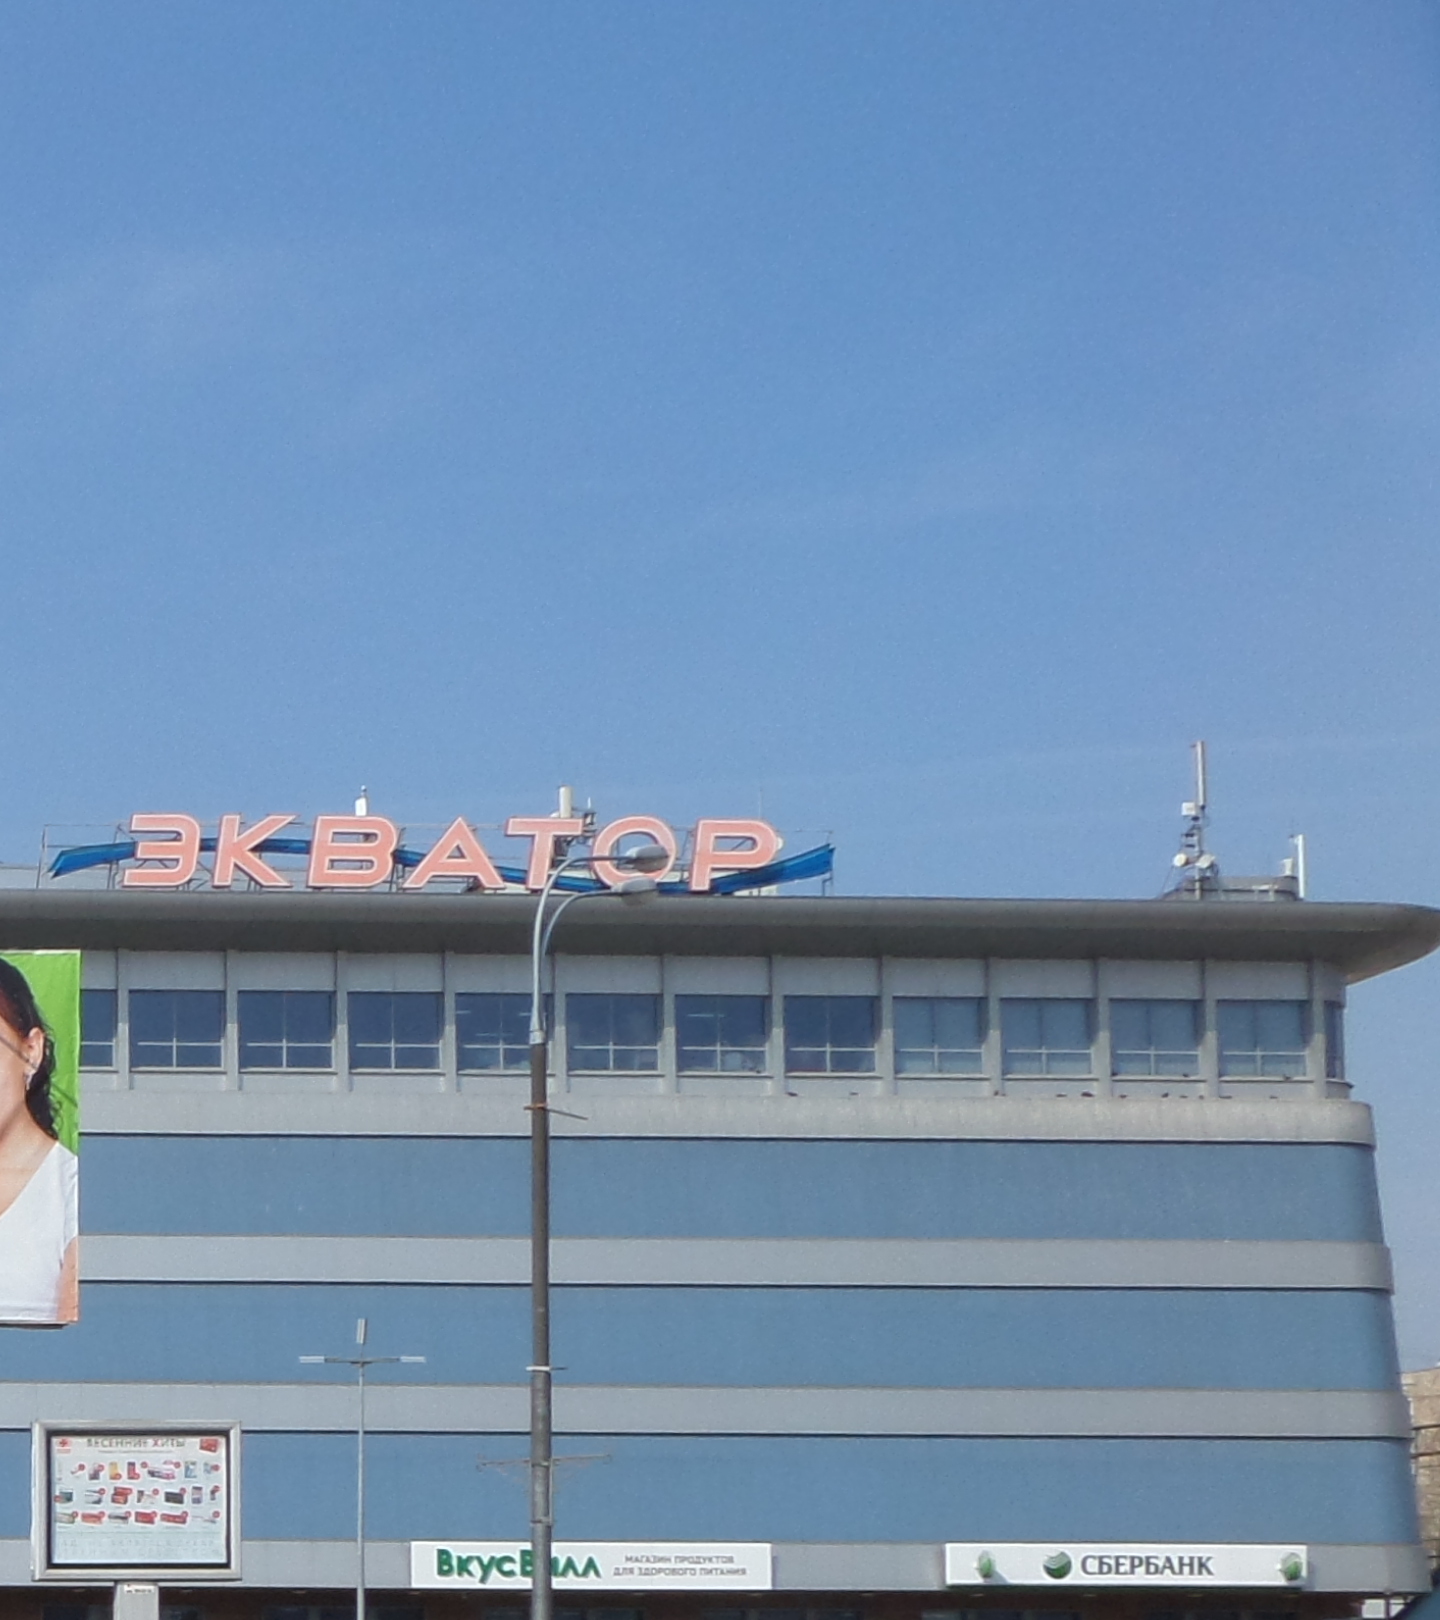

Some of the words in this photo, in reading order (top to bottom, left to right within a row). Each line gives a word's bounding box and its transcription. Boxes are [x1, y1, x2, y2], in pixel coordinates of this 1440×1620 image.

[124, 814, 778, 892] ЭКВАТОР
[625, 1555, 671, 1564] МАГАЗИН
[674, 1555, 735, 1565] ПРОДУКТОВ
[1081, 1555, 1214, 1576] СБЕРБАНК
[613, 1567, 635, 1578] ДЛЯ
[638, 1567, 697, 1577] ЗДОРОВОГО
[699, 1567, 747, 1577] ПИТАНИЯ
